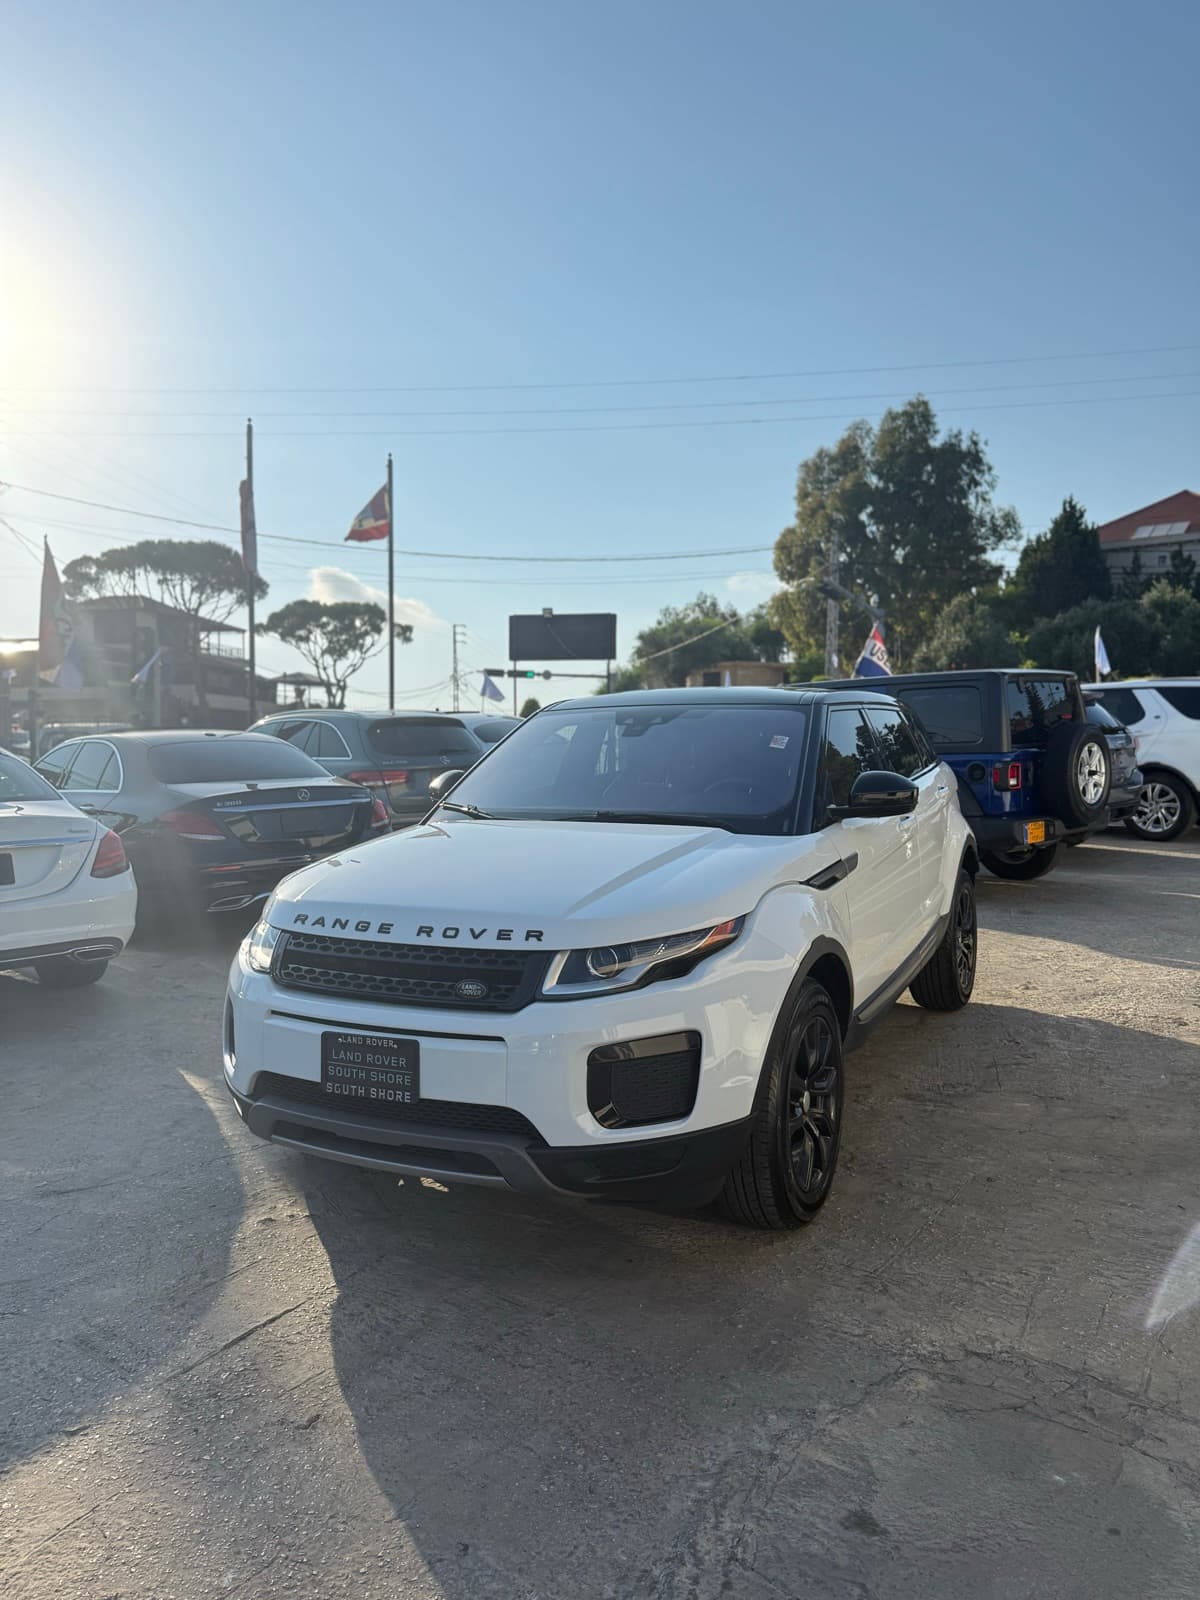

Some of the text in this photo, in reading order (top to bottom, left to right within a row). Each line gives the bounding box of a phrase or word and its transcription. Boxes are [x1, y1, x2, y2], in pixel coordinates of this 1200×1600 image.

[293, 913, 544, 942] RANGE ROVER
[342, 1035, 395, 1049] LAND ROVER
[332, 1047, 407, 1068] LAND ROVER
[328, 1065, 412, 1086] SOUTH SHORE
[326, 1081, 412, 1103] SOUTH SHORE
